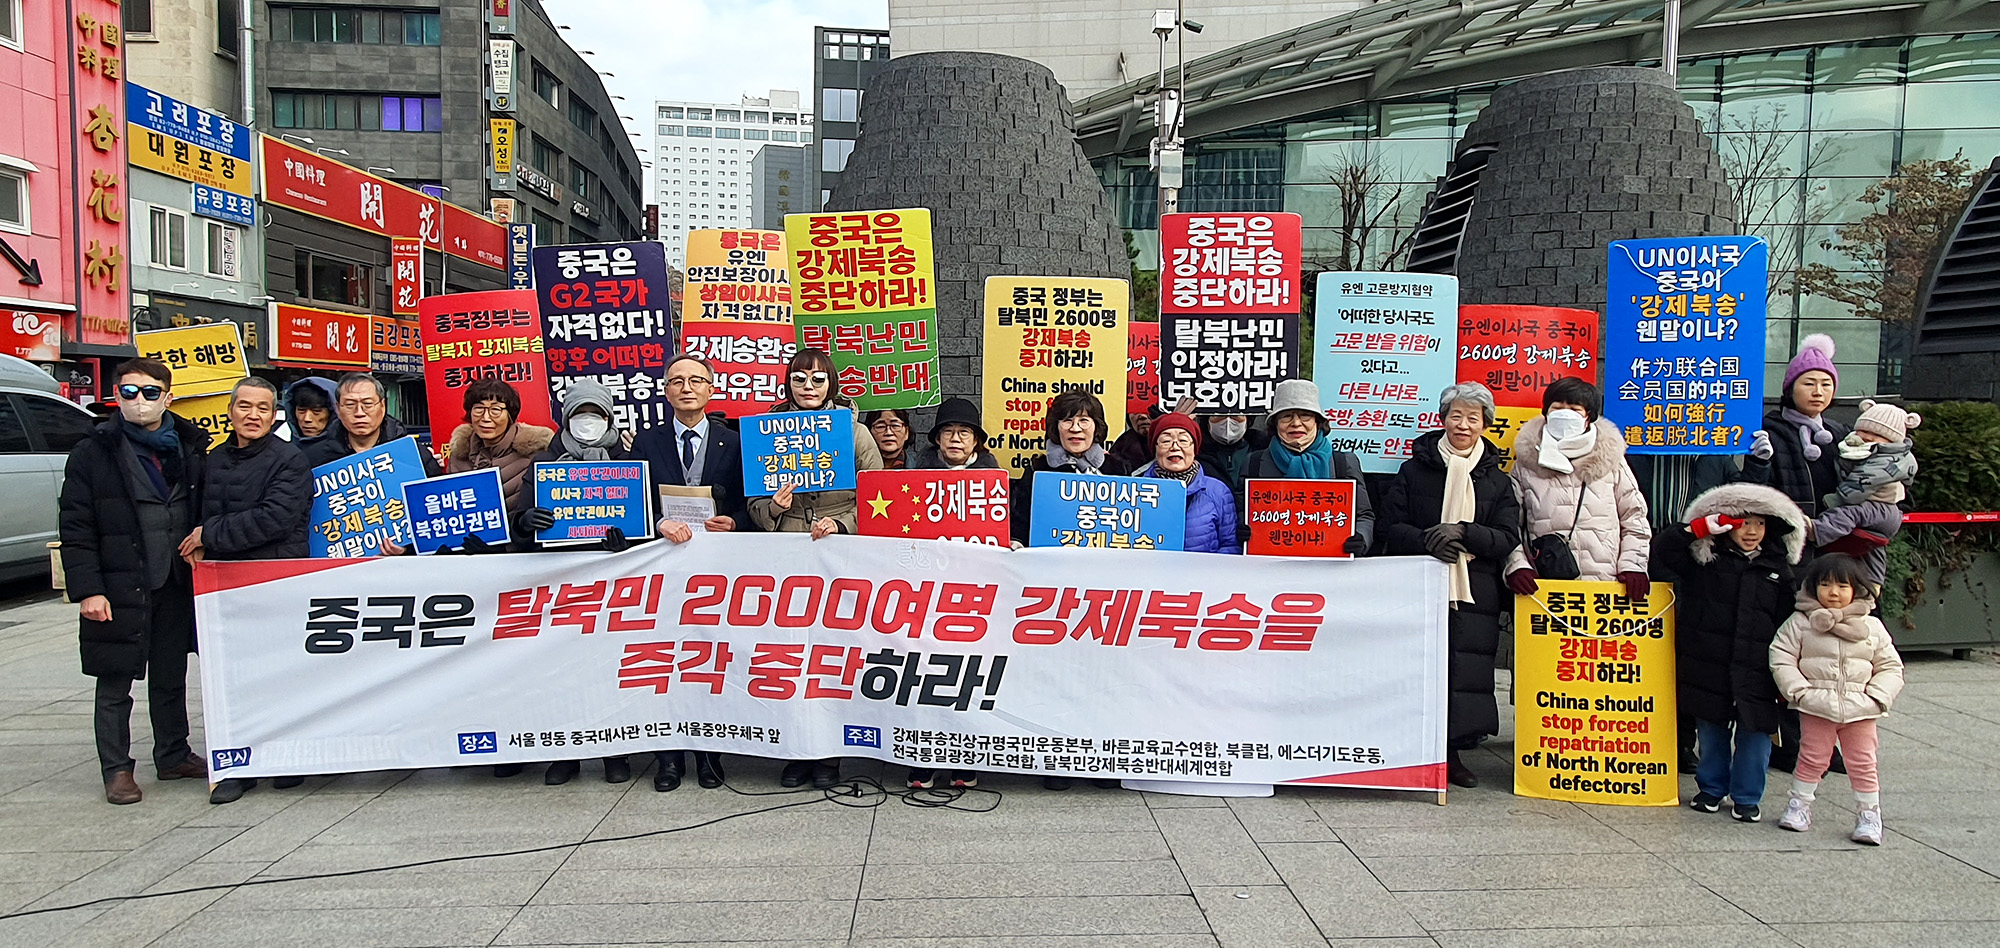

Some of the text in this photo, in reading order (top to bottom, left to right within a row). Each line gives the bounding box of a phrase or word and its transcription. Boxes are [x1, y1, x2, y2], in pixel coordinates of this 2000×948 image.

[77, 12, 120, 47] 中國
[78, 45, 120, 80] 料理
[494, 49, 509, 58] 수집
[146, 91, 235, 143] 고려포장
[147, 131, 236, 179] 대원포장
[496, 136, 508, 159] 오성
[284, 157, 327, 187] 中國料理
[84, 104, 123, 293] 杏花村
[196, 187, 252, 215] 유명포장
[360, 181, 440, 244] 開花
[720, 232, 781, 251] 중국은
[809, 213, 903, 248] 중국은
[1187, 217, 1274, 247] 중국은
[558, 249, 637, 279] 중국은
[728, 250, 766, 266] 유엔
[796, 246, 916, 280] 강제북송
[1173, 247, 1284, 276] 강제북송
[1639, 245, 1740, 268] UN이사국
[397, 260, 417, 308] 開花
[1173, 278, 1290, 307] 중단하라!
[1341, 283, 1433, 297] 유엔 고문방지협약
[1657, 269, 1721, 293] 중국이
[550, 279, 648, 308] G2 국가
[800, 278, 927, 312] 중단하라!
[1013, 288, 1103, 307] 중국 정부는
[701, 303, 791, 323] 자격없다!
[1338, 308, 1435, 325] '어떠한 당사국도
[1631, 293, 1745, 318] '강제북송'
[435, 309, 531, 332] 중국정부는
[548, 310, 665, 342] 자격없다!
[998, 308, 1117, 328] 탈북민 2600명
[326, 321, 359, 353] 開花
[373, 322, 422, 349] 금강포장
[802, 320, 928, 355] 탈북난민
[1023, 328, 1091, 348] 강제북송
[1175, 319, 1284, 348] 탈북난민
[1460, 319, 1592, 341] 유엔이사국 중국이
[1636, 318, 1739, 342] 웬말이냐?
[193, 342, 236, 365] 해방
[426, 336, 544, 361] 탈북자 강제북송
[1330, 332, 1441, 352] 고문 받을 위험이
[547, 344, 664, 372] 향후 어떠한
[1020, 349, 1093, 368] 중지하라!
[1171, 350, 1288, 379] 인정하라!
[1361, 360, 1410, 375] 있다고...
[1460, 344, 1591, 369] 2600명 강제북송
[1631, 357, 1739, 378] 作为联合国
[444, 361, 532, 388] 중지하라!
[839, 362, 930, 397] 송반대
[1001, 377, 1047, 394] China
[1168, 381, 1278, 409] 보호하라
[1339, 383, 1370, 400] 다른
[1619, 380, 1749, 401] 会员国的中国
[1005, 398, 1042, 414] stop
[1644, 403, 1726, 423] 如何強行
[759, 415, 833, 434] UN이사국
[1388, 411, 1415, 428] 또는
[1489, 418, 1511, 439] 국
[773, 434, 821, 452] 중국이
[988, 434, 1006, 449] of
[1332, 438, 1401, 455] 하여서는 안
[758, 450, 839, 473] '강제북송'
[538, 467, 640, 482] 중국은 유엔 인권이사회
[763, 470, 836, 492] 웬말이냐?
[328, 480, 386, 516] 중국이
[424, 488, 477, 514] 올바른
[551, 487, 629, 500] 이사국 자격 없다!
[925, 481, 1008, 522] 강제북송
[1060, 480, 1160, 508] UN이사국
[1251, 491, 1347, 505] 유엔이사국 중국이
[416, 508, 502, 539] 북한인권법
[553, 505, 626, 520] 유엔 인권이사국
[1076, 505, 1141, 532] 중국이
[1252, 510, 1348, 527] 2600명 강제북송
[1269, 530, 1324, 546] 웬말이냐!
[304, 574, 1326, 656] 중국은 탈북민 2600여명 강제북송을
[1547, 592, 1649, 615] 중국 정부는
[1530, 614, 1664, 639] 탈북민 2600명
[1559, 639, 1638, 661] 강제북송
[618, 640, 1009, 711] 즉각 중단하라!
[1556, 661, 1641, 683] 중지하라!
[1536, 691, 1654, 712] China should
[509, 721, 781, 749] 서울 명동 중국대사관 인근 서울중앙우체국 앞
[1541, 714, 1649, 735] stop forced
[461, 735, 494, 752] 장소
[848, 728, 878, 746] 주최
[892, 726, 1386, 766] 강제북송진상규명국민운동본부, 바른교육교수연합, 북클럽, 에스더기도운동,
[1540, 736, 1651, 754] repatriation
[892, 744, 1233, 778] 전국통일광장기도연합, 탈북민강제북송반대세계연합
[1522, 752, 1667, 775] of North Korean
[1549, 774, 1646, 795] defectors!
